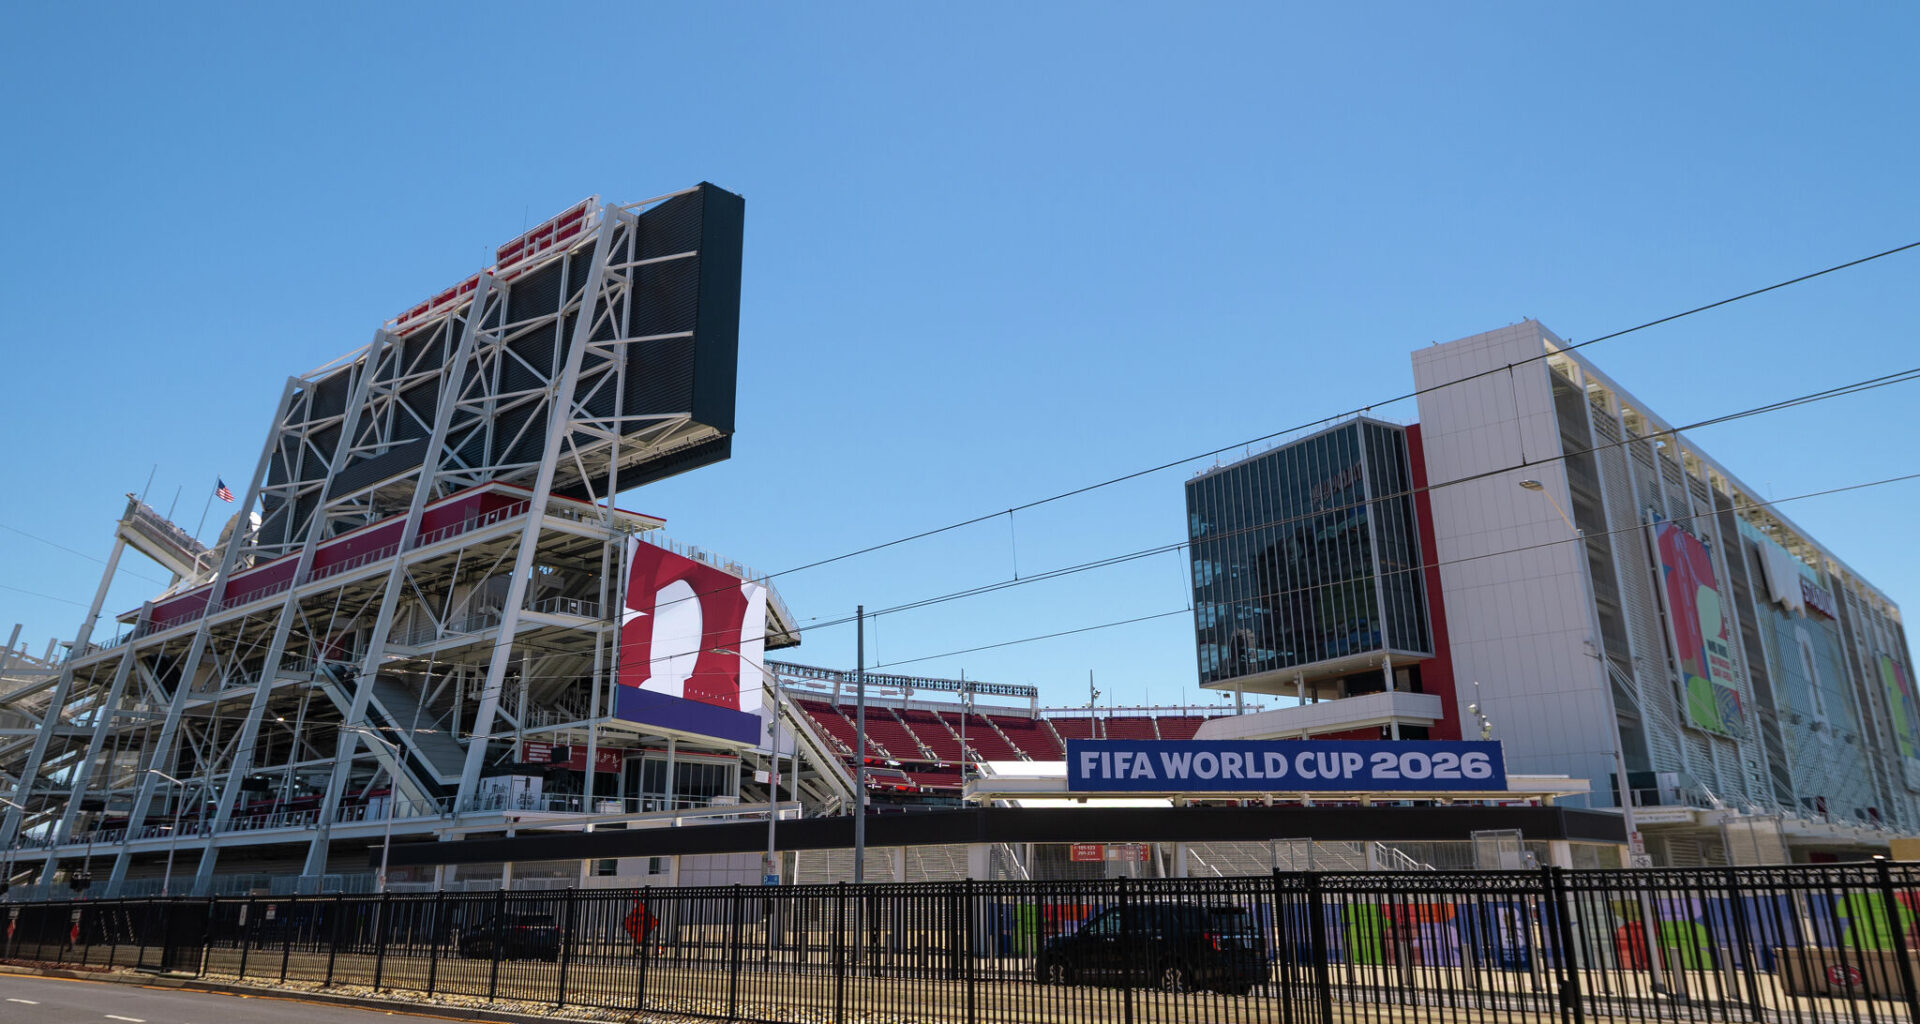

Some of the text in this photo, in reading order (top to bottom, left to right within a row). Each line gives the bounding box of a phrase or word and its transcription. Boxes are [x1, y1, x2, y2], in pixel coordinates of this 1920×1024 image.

[1080, 751, 1493, 780] FIFA WORLD CUP 2026
